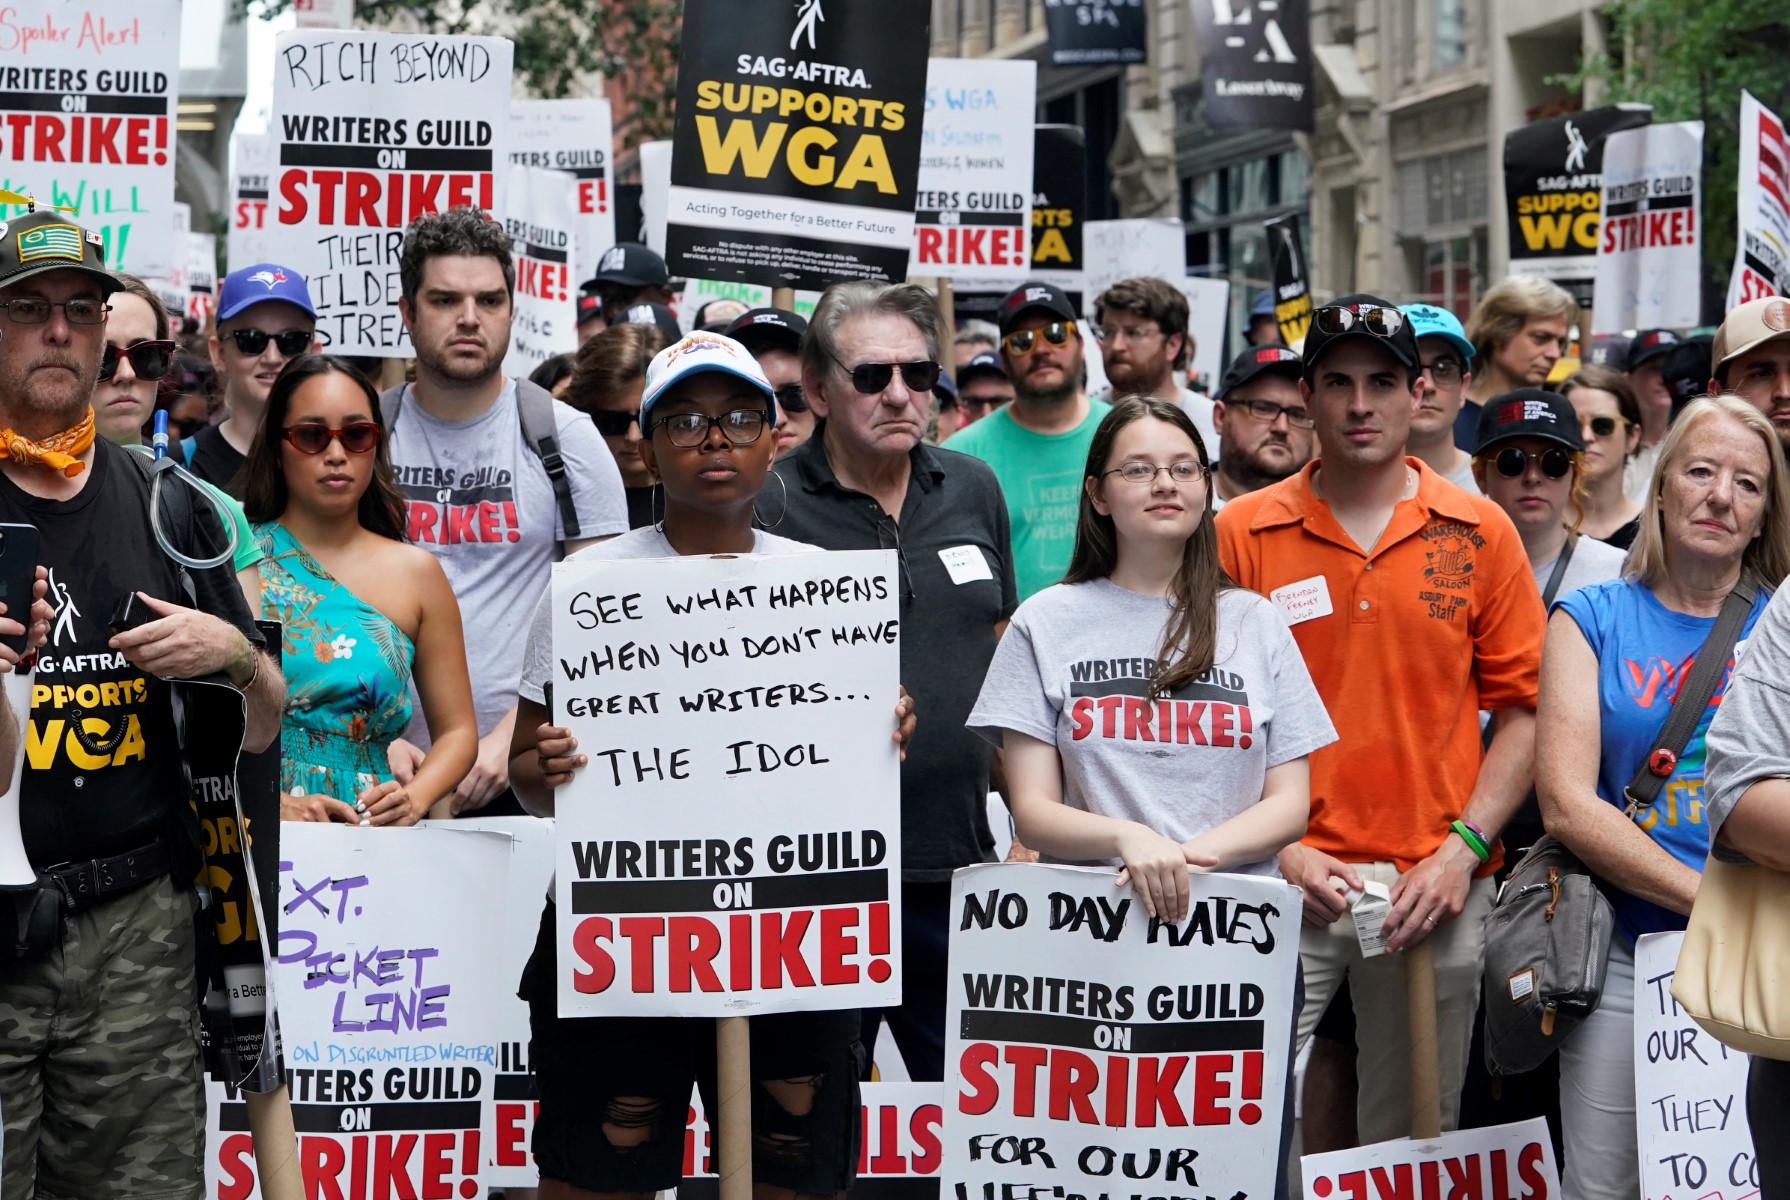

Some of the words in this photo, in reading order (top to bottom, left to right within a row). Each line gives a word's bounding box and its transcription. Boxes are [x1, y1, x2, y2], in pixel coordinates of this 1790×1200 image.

[0, 7, 71, 54] Spoiler
[77, 11, 139, 54] Alert
[0, 67, 88, 92] RITERS
[96, 70, 168, 94] GUILD
[283, 42, 376, 91] RICH
[391, 41, 490, 84] BEYOND
[61, 95, 87, 112] ON
[696, 80, 905, 131] SUPPORTS
[945, 88, 998, 110] WGA
[0, 115, 168, 166] TRIKE!
[282, 115, 407, 145] WRITERS
[416, 120, 492, 147] GUILD
[377, 150, 406, 169] ON
[556, 150, 604, 166] GUILD
[695, 115, 898, 194] WGA
[53, 179, 149, 217] WILL
[279, 168, 494, 227] STRIKE!
[967, 192, 1023, 210] GUILD
[1653, 175, 1694, 194] GUILD
[530, 224, 567, 247] GUILD
[686, 202, 727, 218] Acting
[730, 206, 787, 220] Together
[790, 212, 805, 223] for
[807, 216, 814, 224] a
[816, 216, 853, 229] Better
[857, 221, 896, 234] Future
[939, 212, 960, 225] ON
[1603, 207, 1694, 255] STRIKE!
[318, 231, 402, 270] THEIR
[914, 227, 1024, 266] RIKE!
[1032, 228, 1073, 263] A
[304, 270, 401, 310] ILDE
[437, 488, 451, 503] ON
[1418, 522, 1487, 550] WAREHOUSE
[569, 592, 643, 629] SEE
[666, 585, 758, 615] WHAT
[769, 576, 888, 609] HAPPENS
[1418, 591, 1446, 602] ASBURY
[1449, 595, 1468, 607] PARK
[1433, 579, 1470, 589] SALOON
[1428, 602, 1457, 621] Staff
[560, 641, 660, 681] WHEN
[670, 637, 729, 668] YOU
[742, 626, 821, 659] DON'T
[832, 620, 899, 646] HAVE
[566, 692, 660, 718] GREAT
[680, 682, 870, 713] WRITERS...
[1071, 696, 1253, 750] STRIKE!
[597, 747, 691, 787] THE
[726, 740, 830, 775] IDOL
[571, 837, 754, 878] WRITERS
[766, 830, 887, 873] GUILD
[713, 882, 753, 908] ON
[960, 889, 1028, 931] NO
[1048, 891, 1133, 942] DAY
[572, 902, 892, 994] STRIKE!
[233, 988, 239, 999] a
[332, 984, 450, 1034] LINE
[962, 973, 1134, 1021] WRITERS
[1147, 983, 1264, 1021] GUILD
[293, 1041, 319, 1063] ON
[1093, 1025, 1131, 1050] ON
[1647, 1028, 1708, 1066] OUR
[384, 1067, 481, 1100] GUILD
[959, 1042, 1264, 1127] STRIKE!
[341, 1108, 371, 1131] ON
[1652, 1094, 1733, 1133] THEY
[218, 1130, 479, 1200] SRIKE!
[969, 1133, 1056, 1169] FOR
[1078, 1145, 1200, 1187] OUR
[1659, 1152, 1708, 1190] TO
